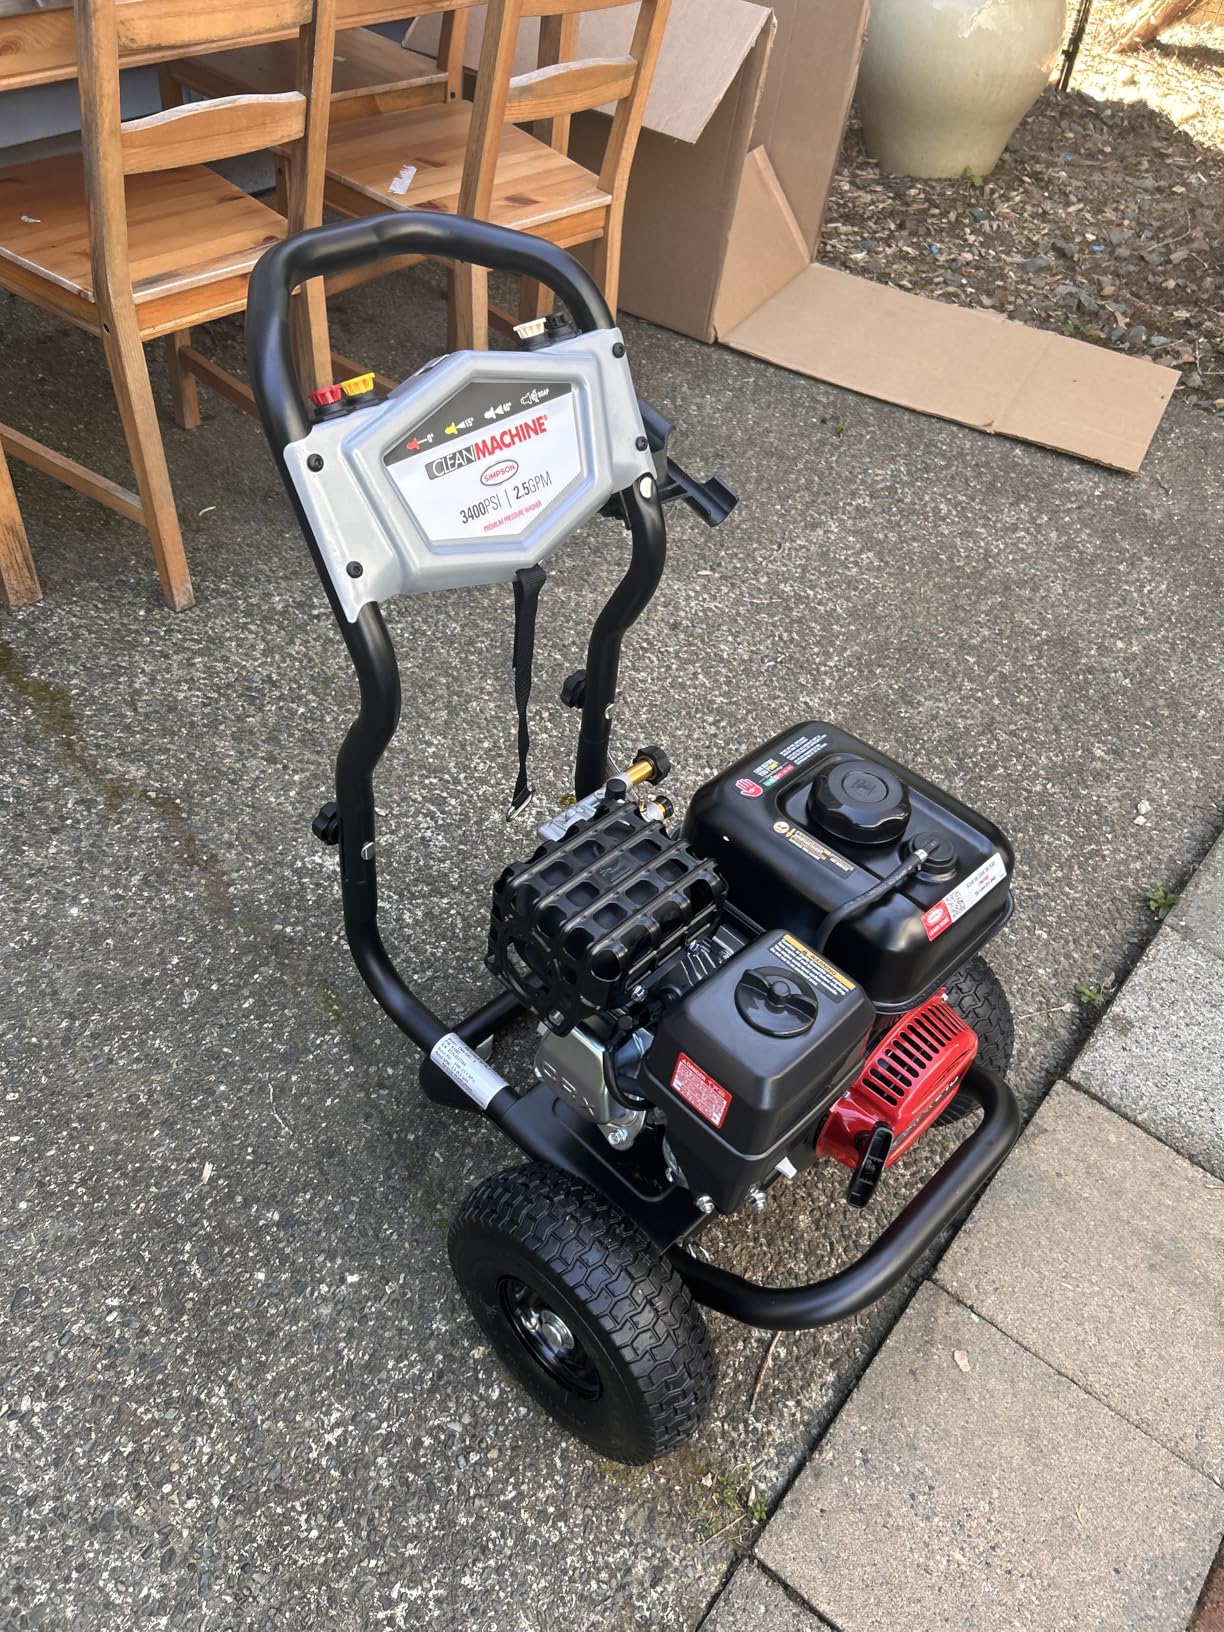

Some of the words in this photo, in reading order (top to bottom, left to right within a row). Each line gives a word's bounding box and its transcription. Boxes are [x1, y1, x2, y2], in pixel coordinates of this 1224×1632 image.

[484, 463, 516, 483] SIMPSON
[459, 493, 502, 524] 3400PSI
[513, 471, 553, 500] 2.5GPM
[483, 517, 505, 533] PREMIUM
[503, 508, 525, 524] PRESSURE
[524, 500, 543, 513] WASHER
